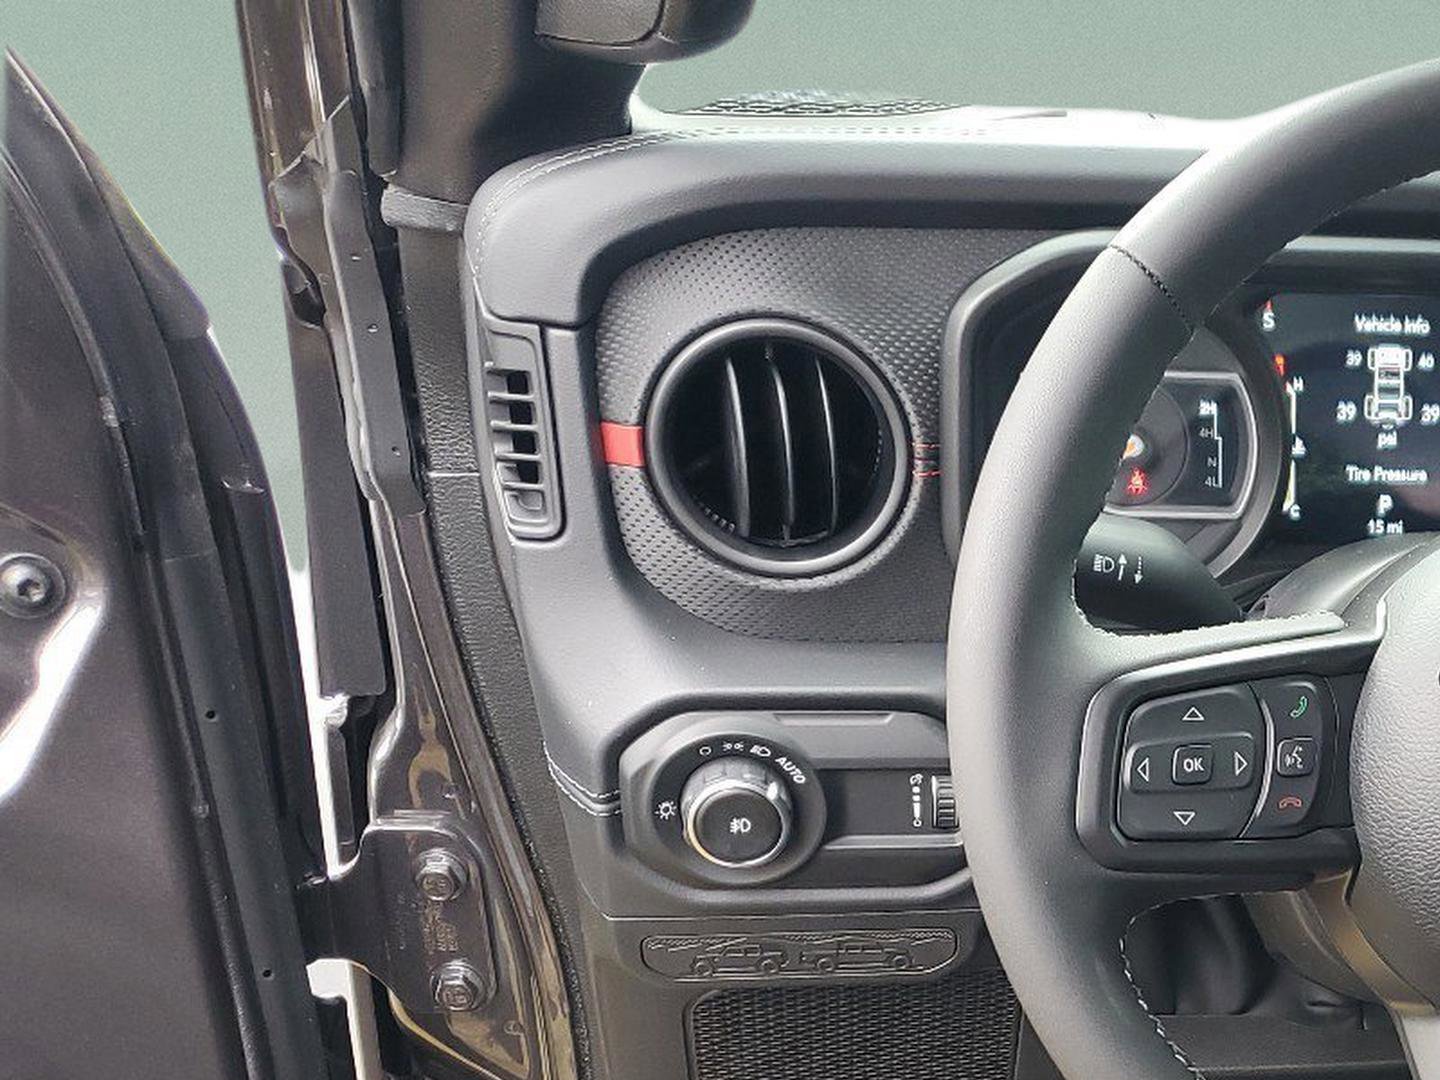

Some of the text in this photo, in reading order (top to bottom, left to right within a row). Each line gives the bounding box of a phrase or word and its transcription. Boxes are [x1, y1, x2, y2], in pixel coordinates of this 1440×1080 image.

[1355, 315, 1430, 334] Vehicle Info
[1377, 432, 1398, 449] psi
[1346, 465, 1428, 482] Tire Pressure
[1379, 495, 1393, 514] P
[1367, 520, 1403, 534] 15 mi
[775, 757, 806, 784] AUTO
[1183, 757, 1204, 771] OK
